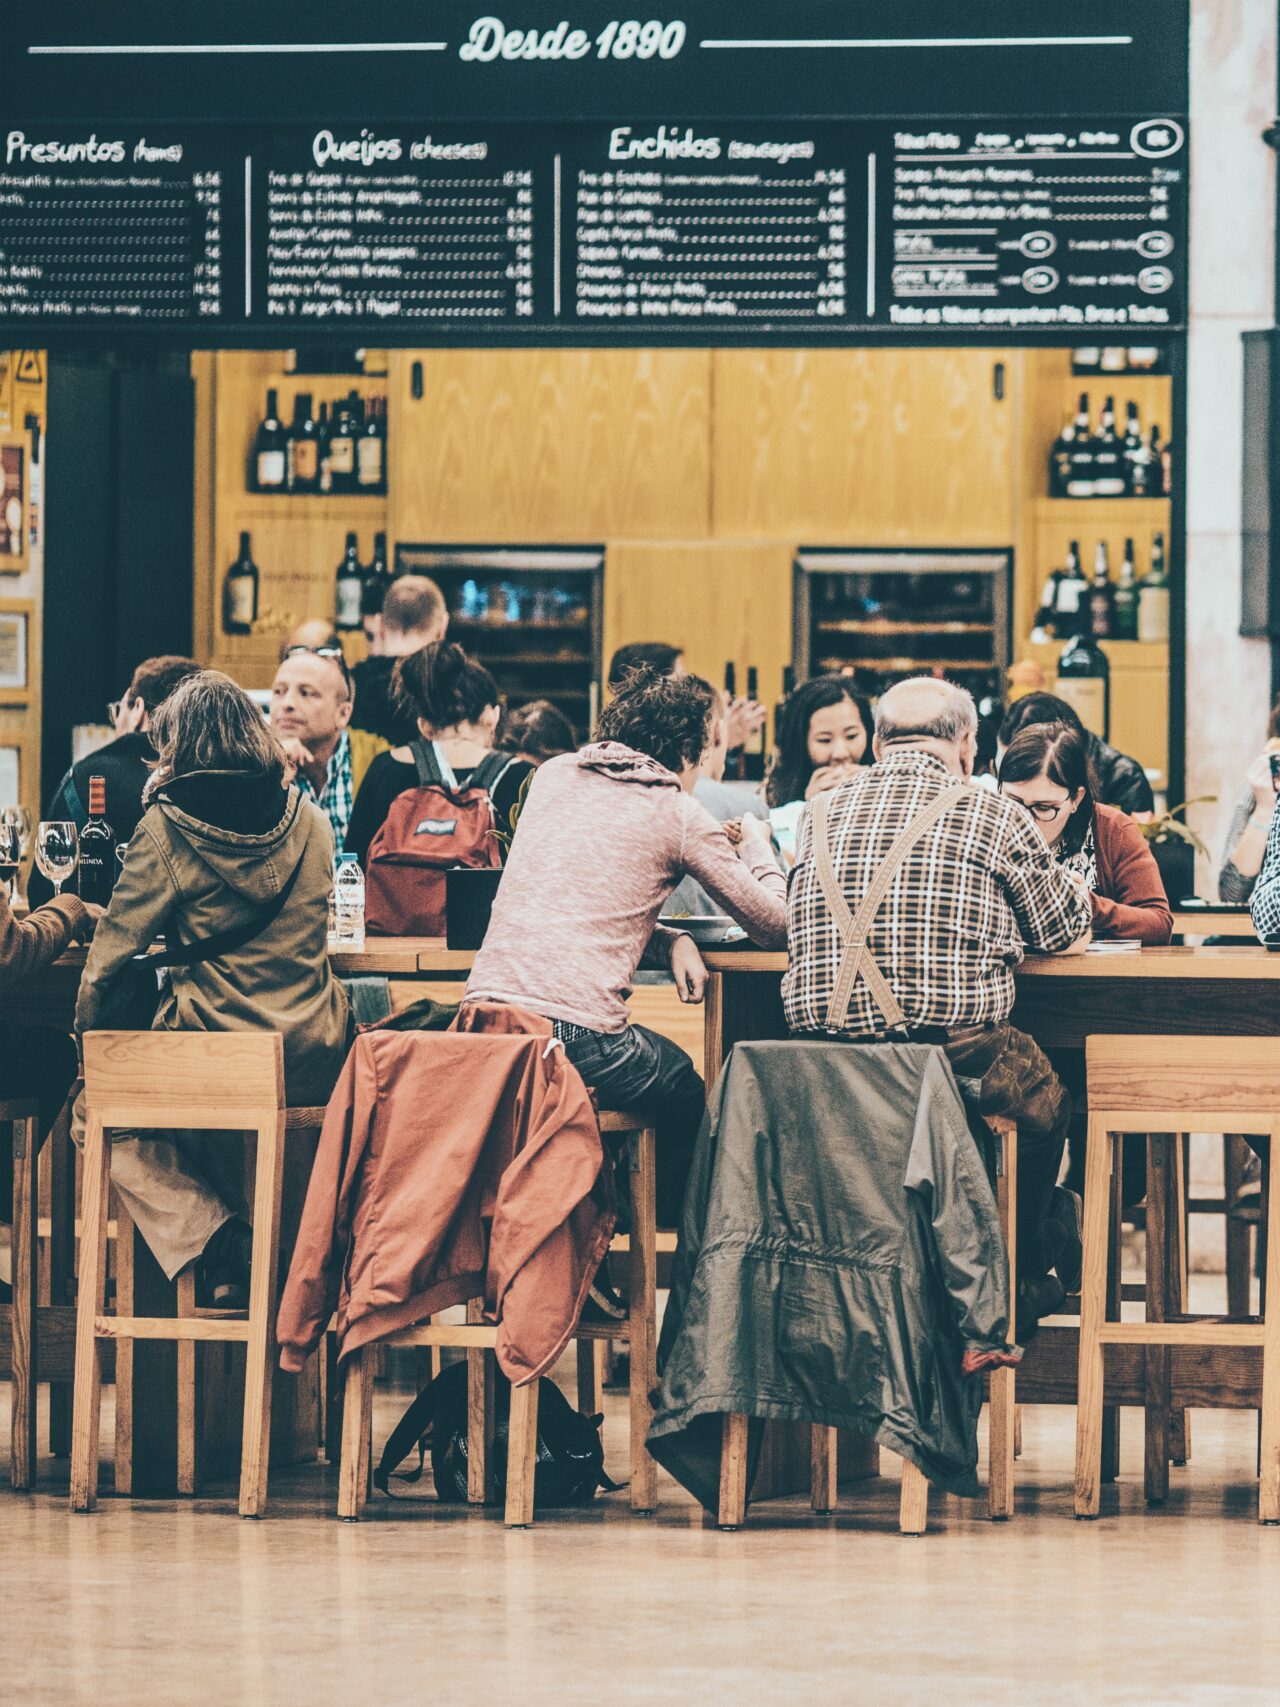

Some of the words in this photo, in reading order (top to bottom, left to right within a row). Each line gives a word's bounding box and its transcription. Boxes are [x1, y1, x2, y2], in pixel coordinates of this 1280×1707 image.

[459, 17, 591, 62] Desde
[596, 20, 686, 59] 1890
[7, 131, 125, 164] Presuntos
[313, 129, 402, 167] Queijos
[609, 126, 721, 160] Enchidos
